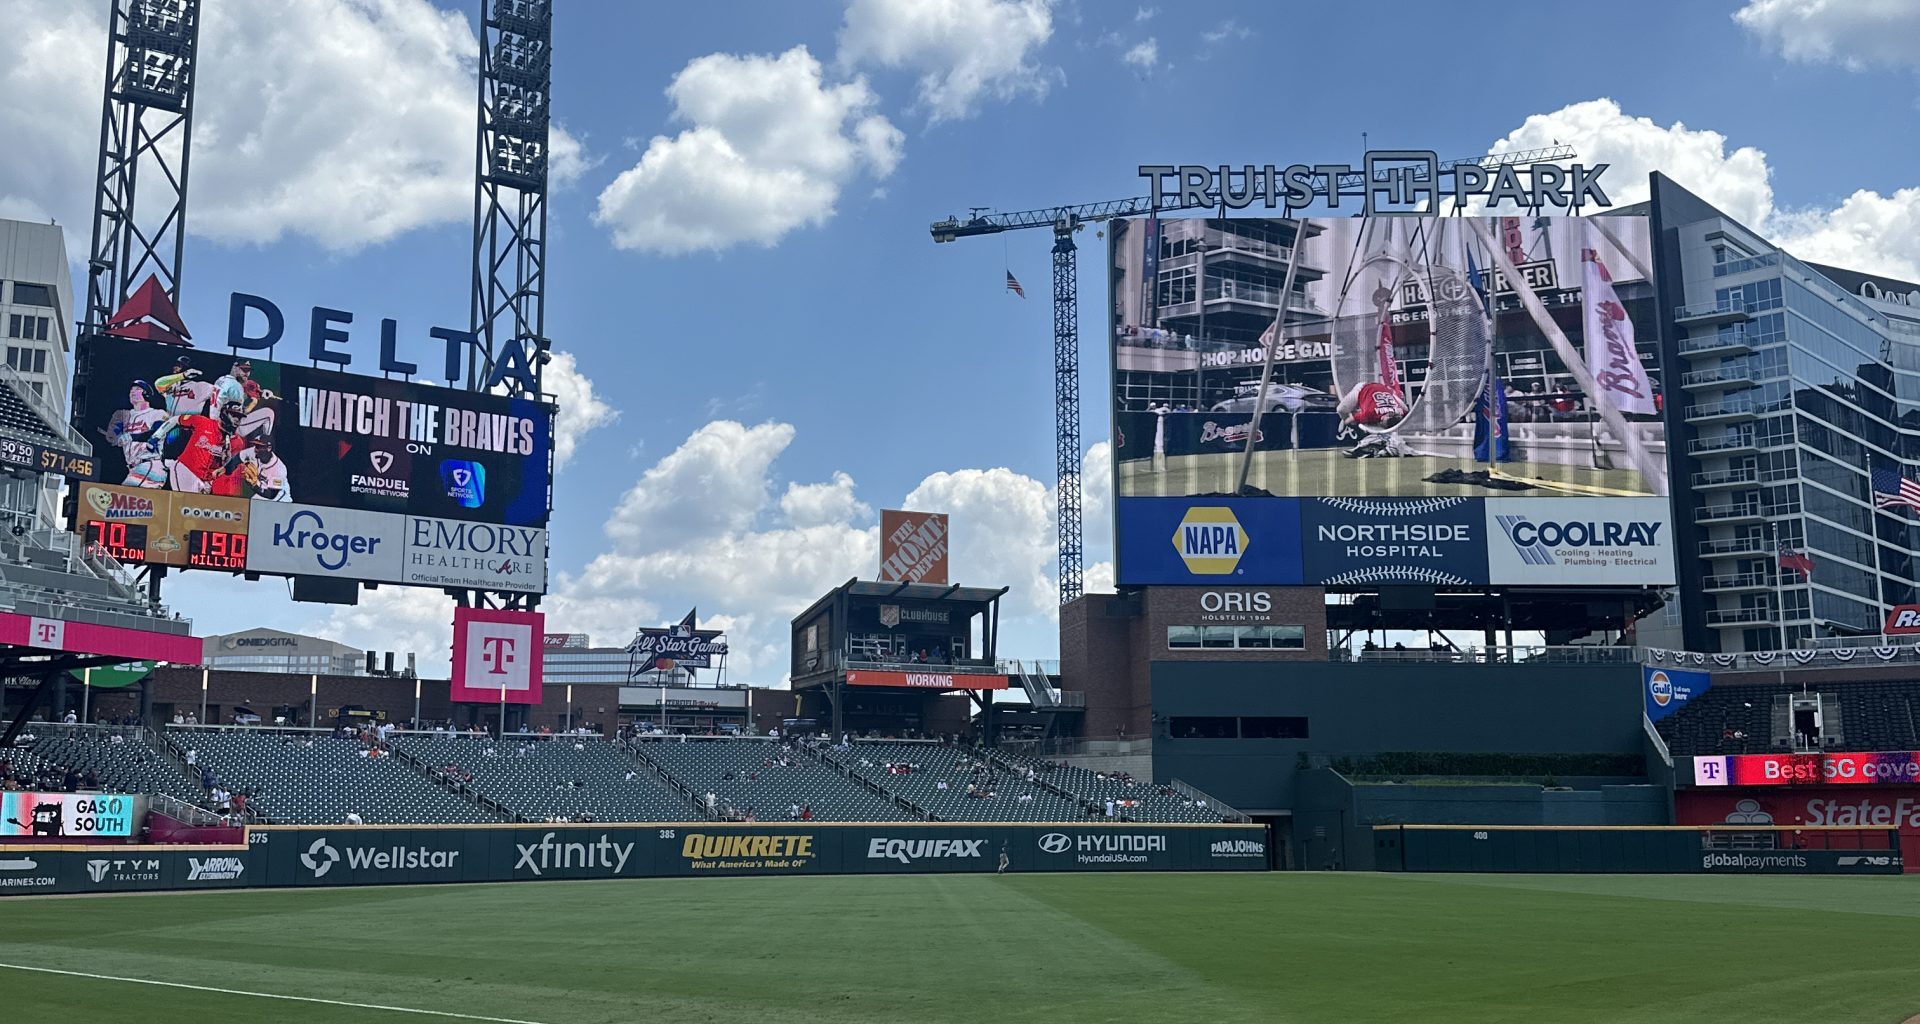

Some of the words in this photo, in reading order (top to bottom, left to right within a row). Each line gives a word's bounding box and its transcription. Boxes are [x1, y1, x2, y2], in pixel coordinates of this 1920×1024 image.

[1139, 165, 1350, 210] TRUIST
[1455, 164, 1612, 208] PARK
[228, 291, 537, 392] DELTA
[298, 386, 391, 438] WATCH
[397, 400, 439, 444] THE
[444, 407, 534, 456] BRAVES
[406, 443, 432, 456] ON
[41, 449, 93, 476] $71,456
[351, 474, 410, 491] FANDUEL
[351, 486, 376, 496] SPORTS
[377, 488, 409, 498] NETWORK
[109, 492, 153, 511] MEGA
[183, 508, 231, 519] POWER
[90, 521, 136, 547] 70
[273, 510, 381, 570] Kroger
[412, 518, 540, 557] EMORY
[888, 520, 916, 547] THE
[1185, 526, 1237, 555] NAPA
[1318, 524, 1470, 542] NORTHSIDE
[1512, 521, 1662, 547] COOLRAY
[201, 531, 247, 558] 190
[883, 514, 948, 582] HOME
[1347, 545, 1443, 557] HOSPITAL
[190, 554, 244, 567] MILLION
[907, 541, 946, 583] DEPOT
[1555, 548, 1590, 559] Cooling
[1598, 549, 1633, 559] Heating
[1564, 557, 1607, 567] Plumbing
[1614, 557, 1657, 566] Electrical
[411, 552, 533, 575] HEALTHCARE
[411, 573, 439, 582] Official
[440, 576, 461, 584] Team
[462, 577, 503, 587] Healthcare
[505, 581, 536, 590] Provider
[1201, 591, 1271, 612] ORIS
[900, 609, 949, 622] CLUBHOUSE
[236, 637, 298, 647] ONEDIGITAL
[625, 635, 656, 653] All
[656, 636, 687, 653] Star
[688, 638, 727, 656] Game
[906, 673, 953, 687] WORKING
[1652, 683, 1671, 695] Gulf
[1764, 760, 1817, 779] Best
[1823, 758, 1856, 778] 5G
[76, 798, 106, 814] GAS
[75, 817, 124, 832] SOUTH
[249, 833, 268, 843] 375
[659, 830, 675, 839] 385
[1078, 835, 1166, 851] HYUNDAI
[1474, 832, 1488, 840] 400
[514, 832, 634, 875] xfinity
[682, 833, 812, 858] QUIKRETE
[867, 838, 984, 864] EQUIFAX
[114, 859, 159, 870] TYM
[202, 858, 237, 872] ARROW
[346, 846, 459, 869] Wellstar
[691, 859, 716, 869] What
[717, 860, 762, 869] America's
[764, 860, 790, 868] Made
[1078, 854, 1147, 863] HyundaiUSA.com
[1703, 854, 1806, 869] globalpayments
[0, 877, 56, 887] ARINES.COM
[113, 872, 159, 881] TRACTORS
